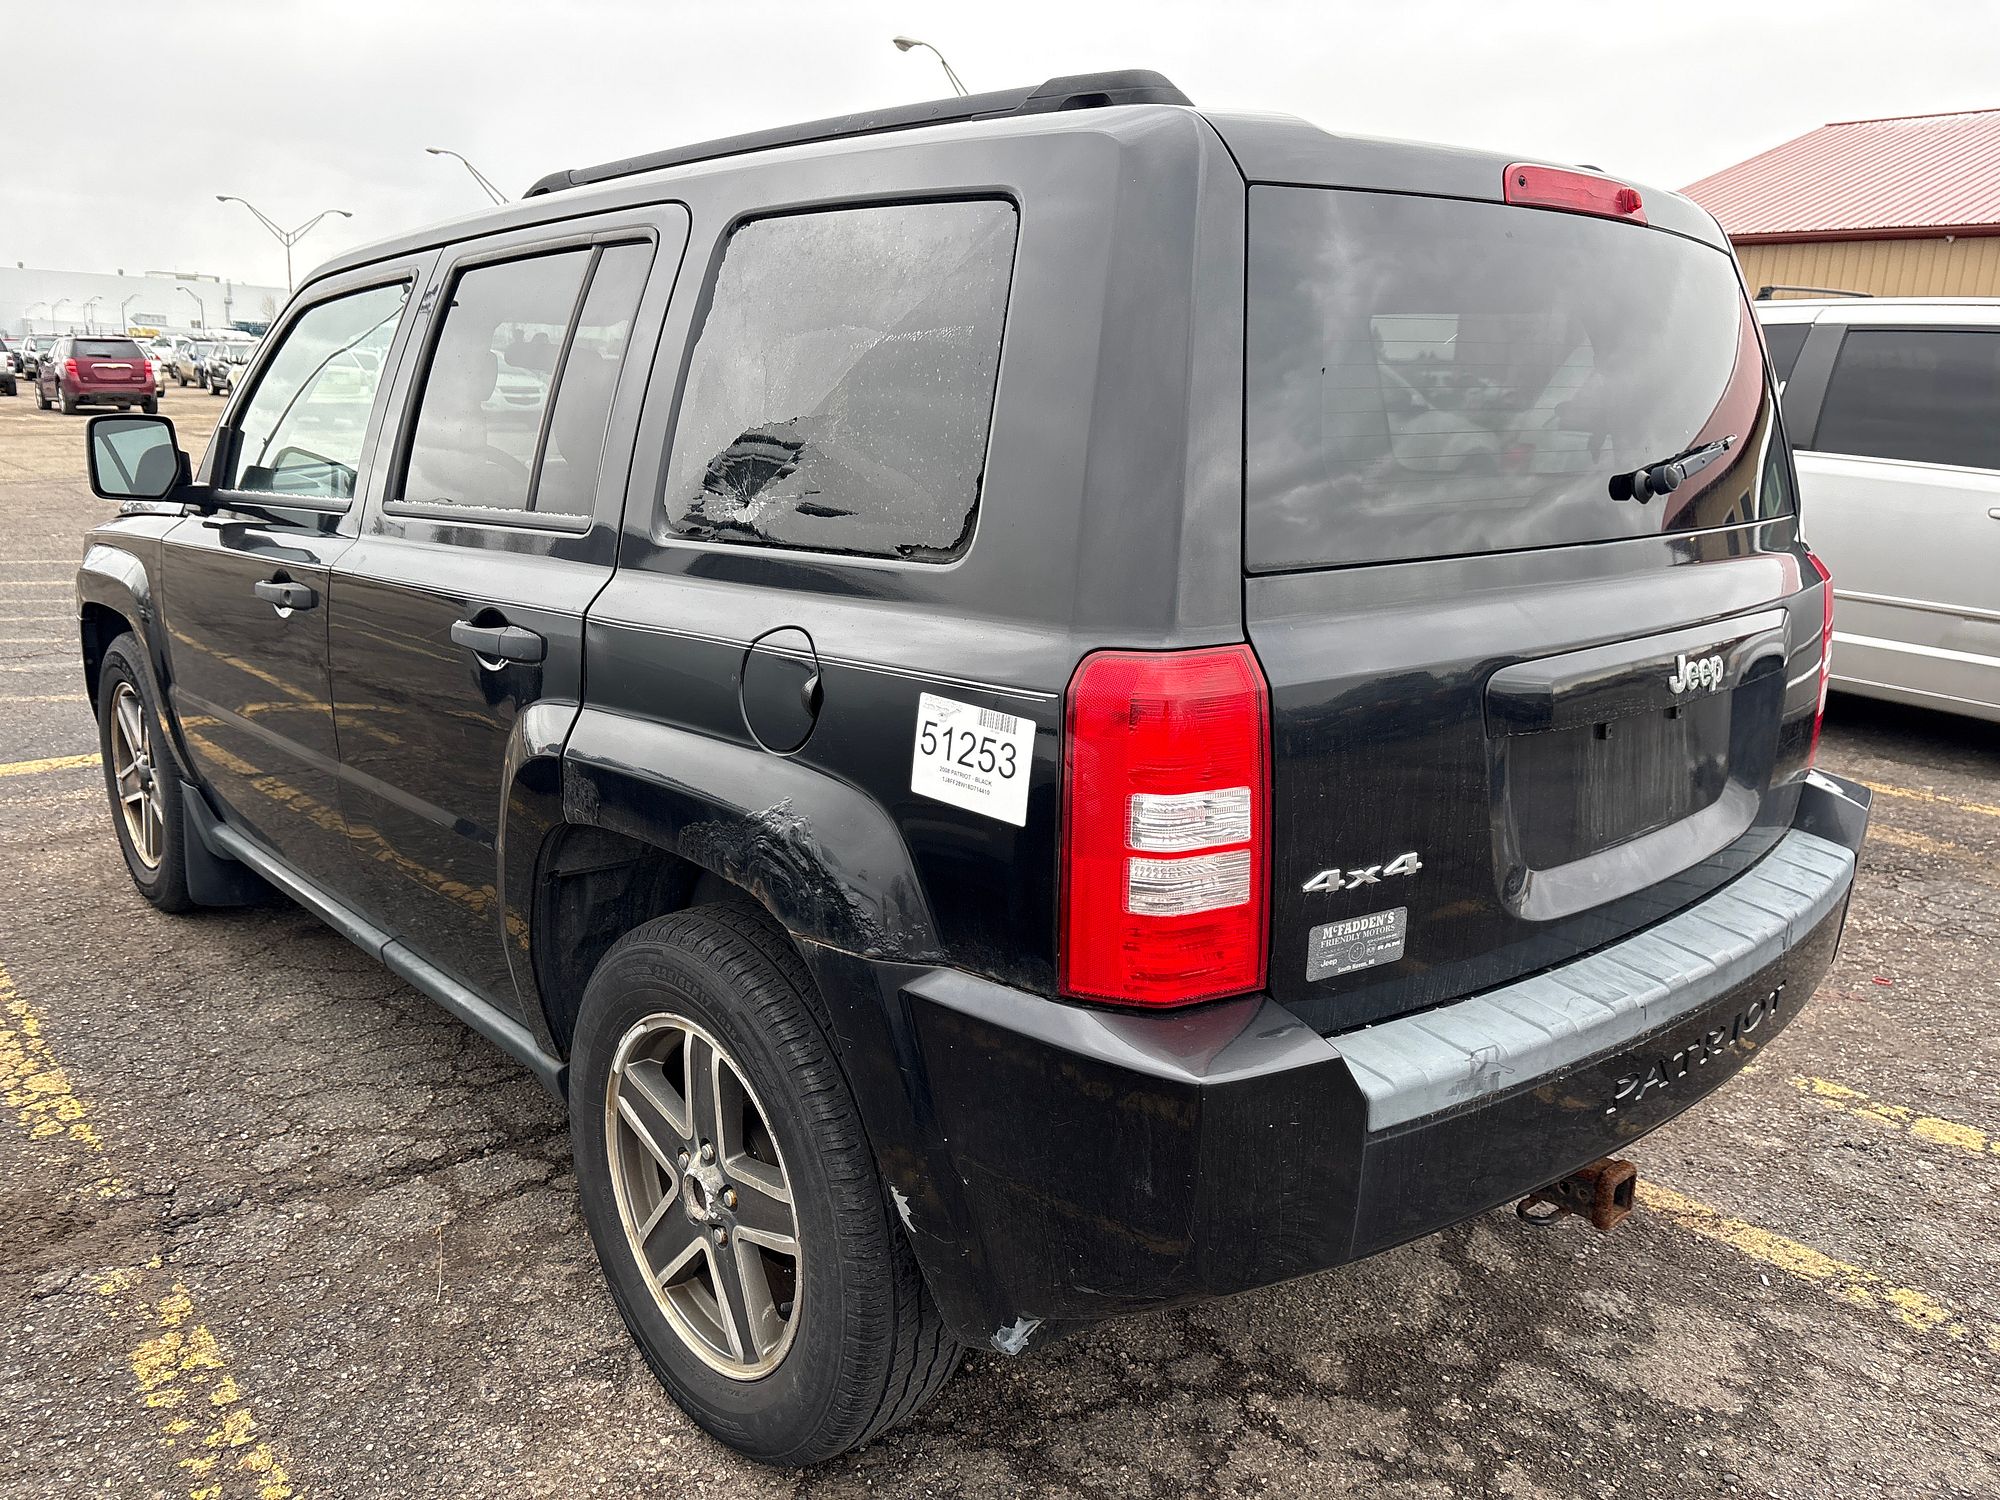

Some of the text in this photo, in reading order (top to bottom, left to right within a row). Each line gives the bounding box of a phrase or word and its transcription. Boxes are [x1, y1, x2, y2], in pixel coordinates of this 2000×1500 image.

[1668, 654, 1724, 694] Jeep
[920, 720, 1016, 779] 51253
[950, 768, 971, 780] PATRIOT
[974, 776, 993, 787] BLACK
[1302, 851, 1423, 893] 4x4
[1320, 923, 1395, 948] FRIENDLY MOTORS
[1377, 940, 1400, 951] RAM
[1320, 958, 1338, 968] Jeep
[1606, 979, 1787, 1114] PATRIOT
